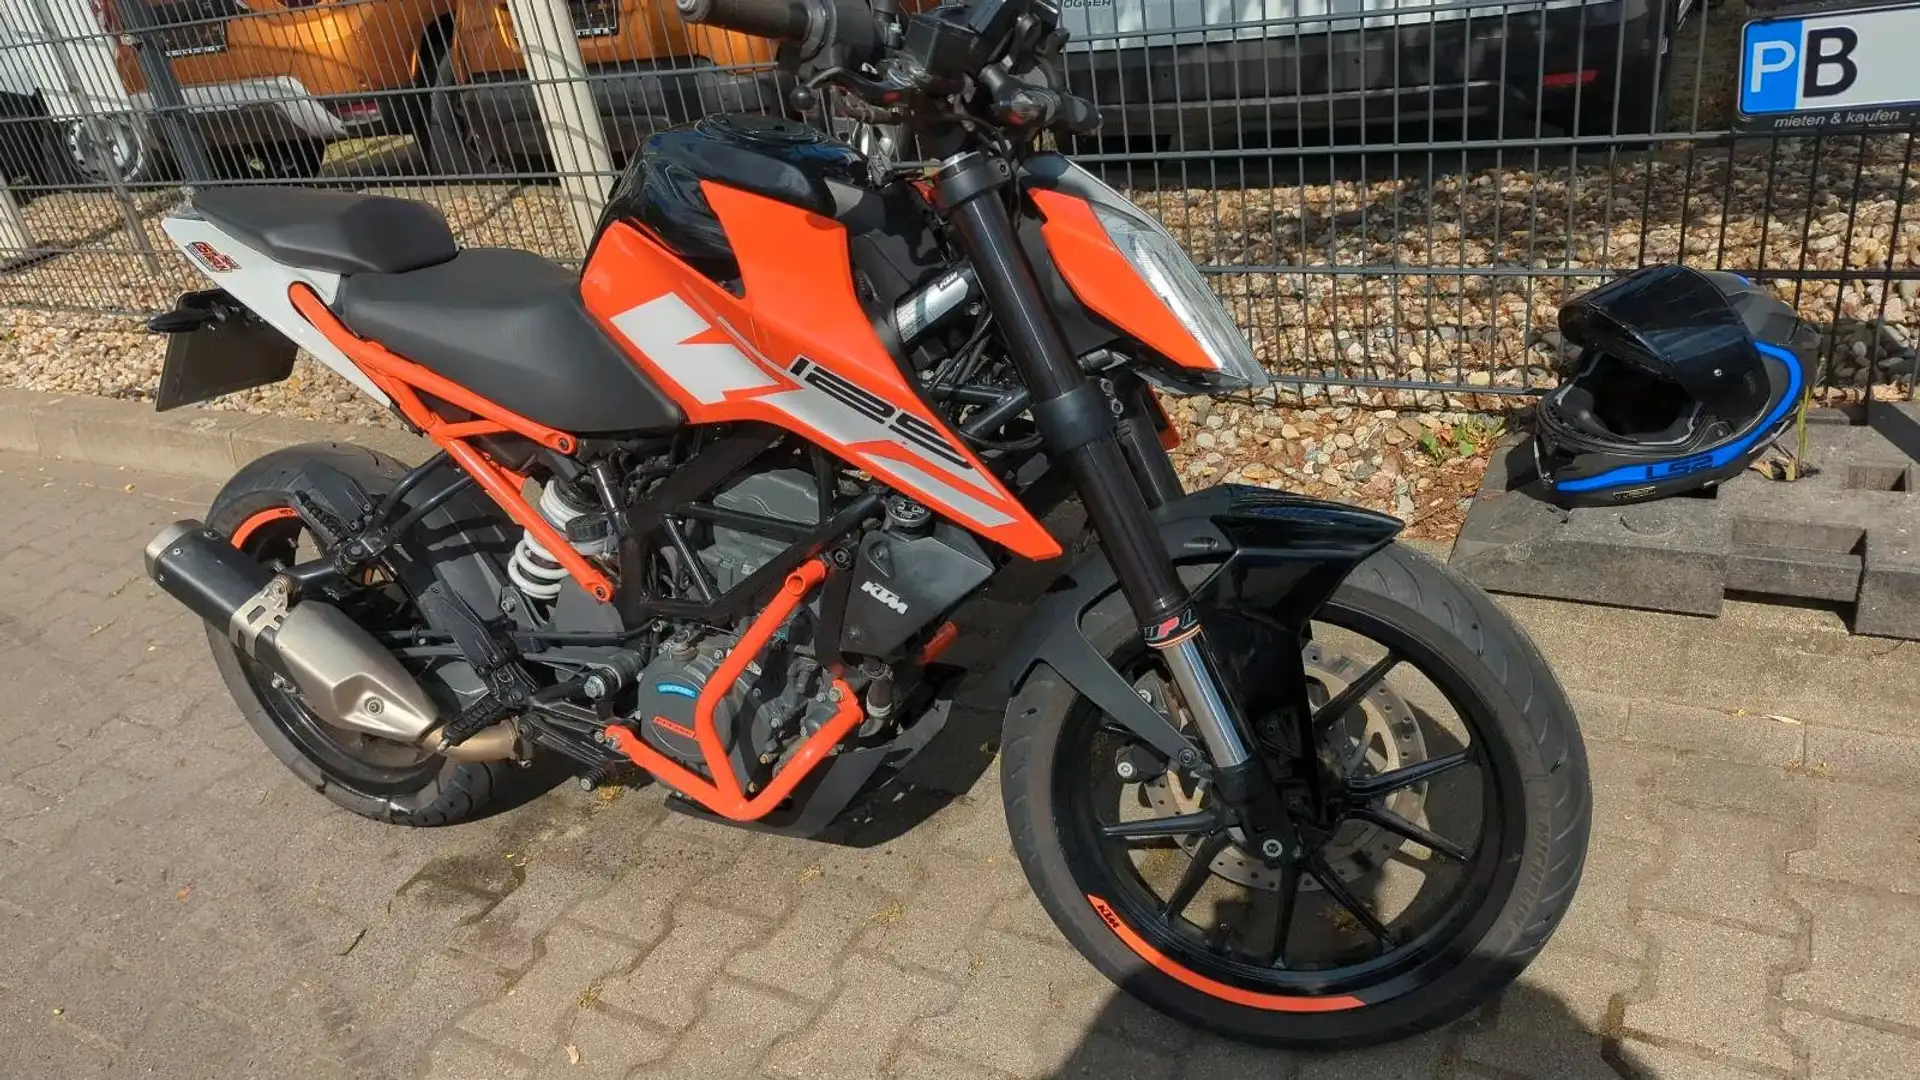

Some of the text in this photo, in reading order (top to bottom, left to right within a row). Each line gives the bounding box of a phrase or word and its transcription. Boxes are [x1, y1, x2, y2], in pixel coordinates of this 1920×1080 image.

[1751, 27, 1858, 98] P B
[1773, 114, 1826, 128] mieten
[1830, 112, 1842, 125] &
[1846, 109, 1901, 124] kaufen
[790, 356, 974, 470] 125
[1645, 454, 1714, 480] LS2
[861, 580, 909, 615] KTM
[1097, 904, 1120, 929] KTM
